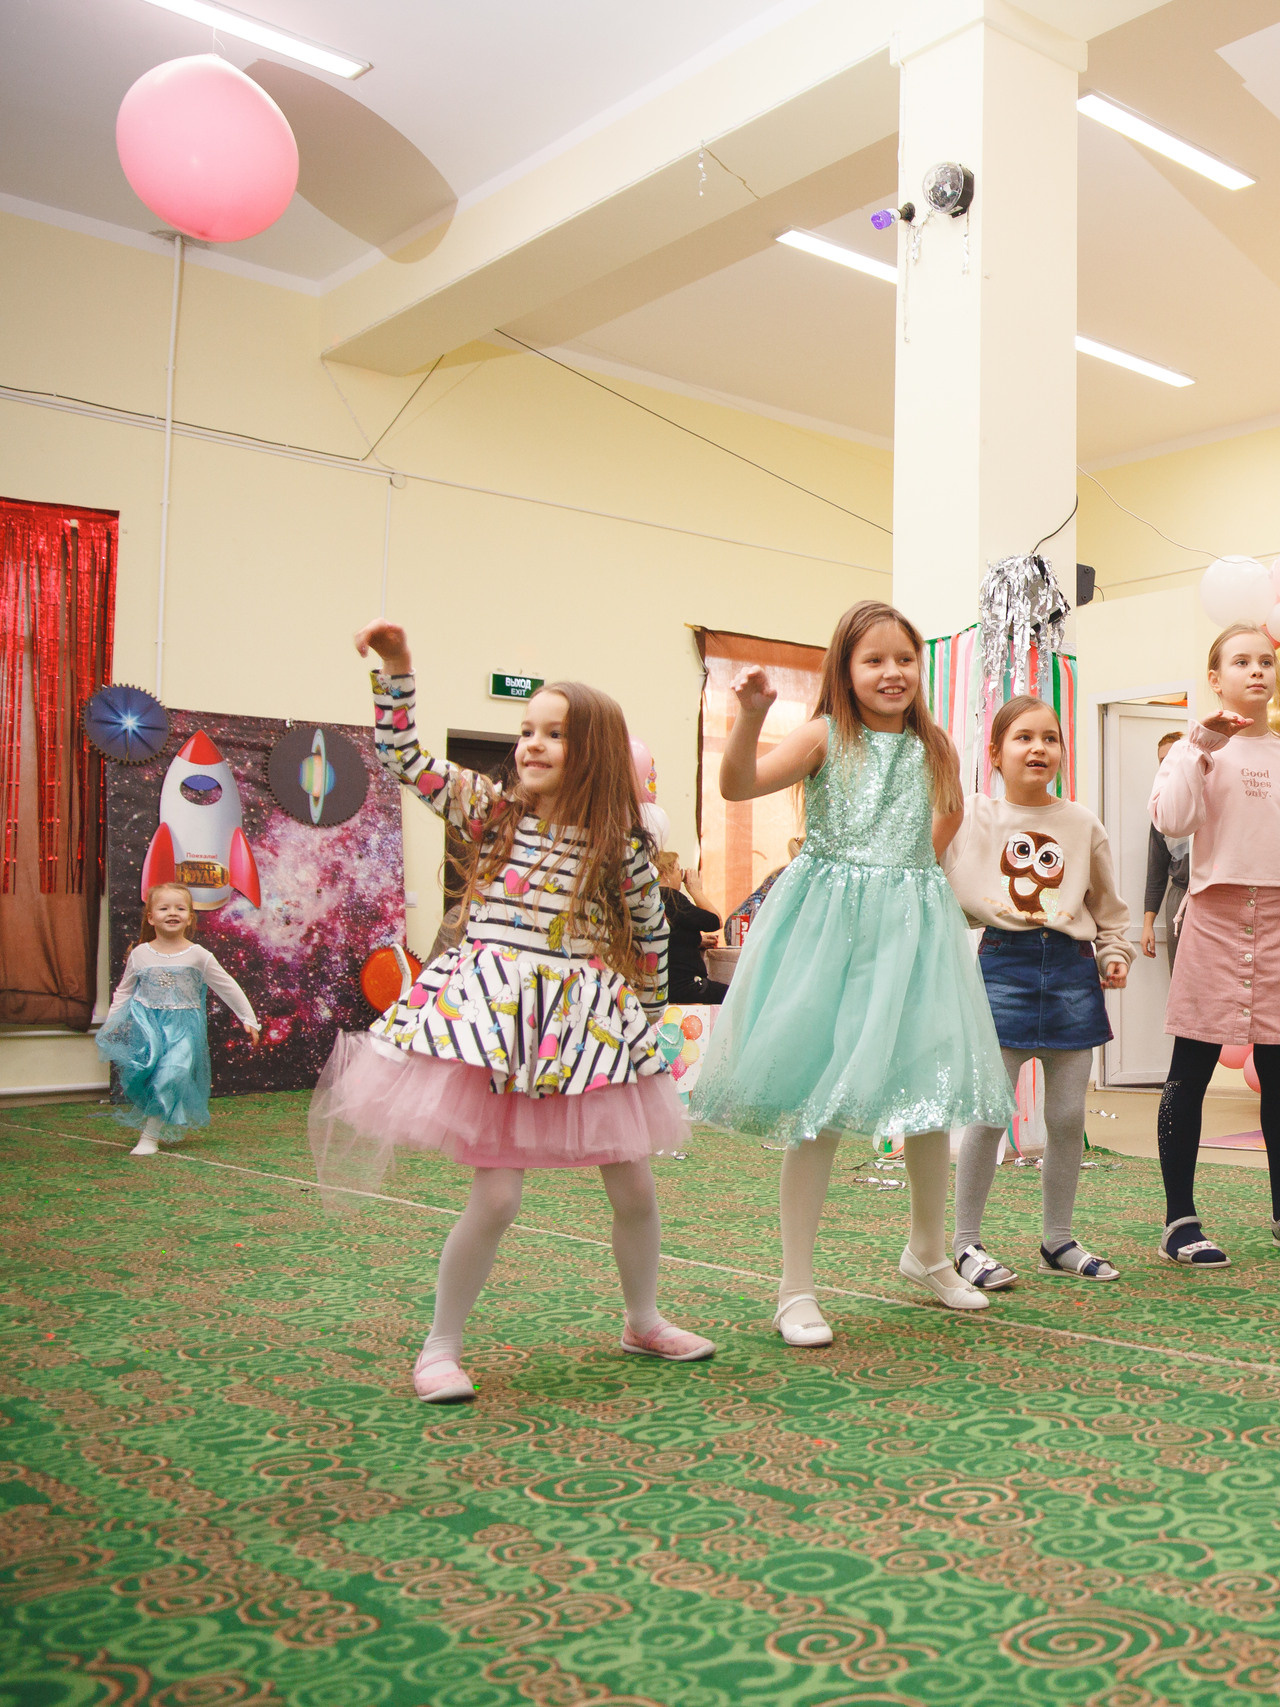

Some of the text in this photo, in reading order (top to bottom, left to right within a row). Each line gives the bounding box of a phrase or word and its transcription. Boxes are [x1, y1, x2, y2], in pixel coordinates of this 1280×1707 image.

[505, 677, 531, 690] ВЫХОД
[511, 688, 526, 696] EXIT
[1241, 768, 1270, 778] Good
[1242, 778, 1271, 788] vibes
[1245, 789, 1272, 799] only.
